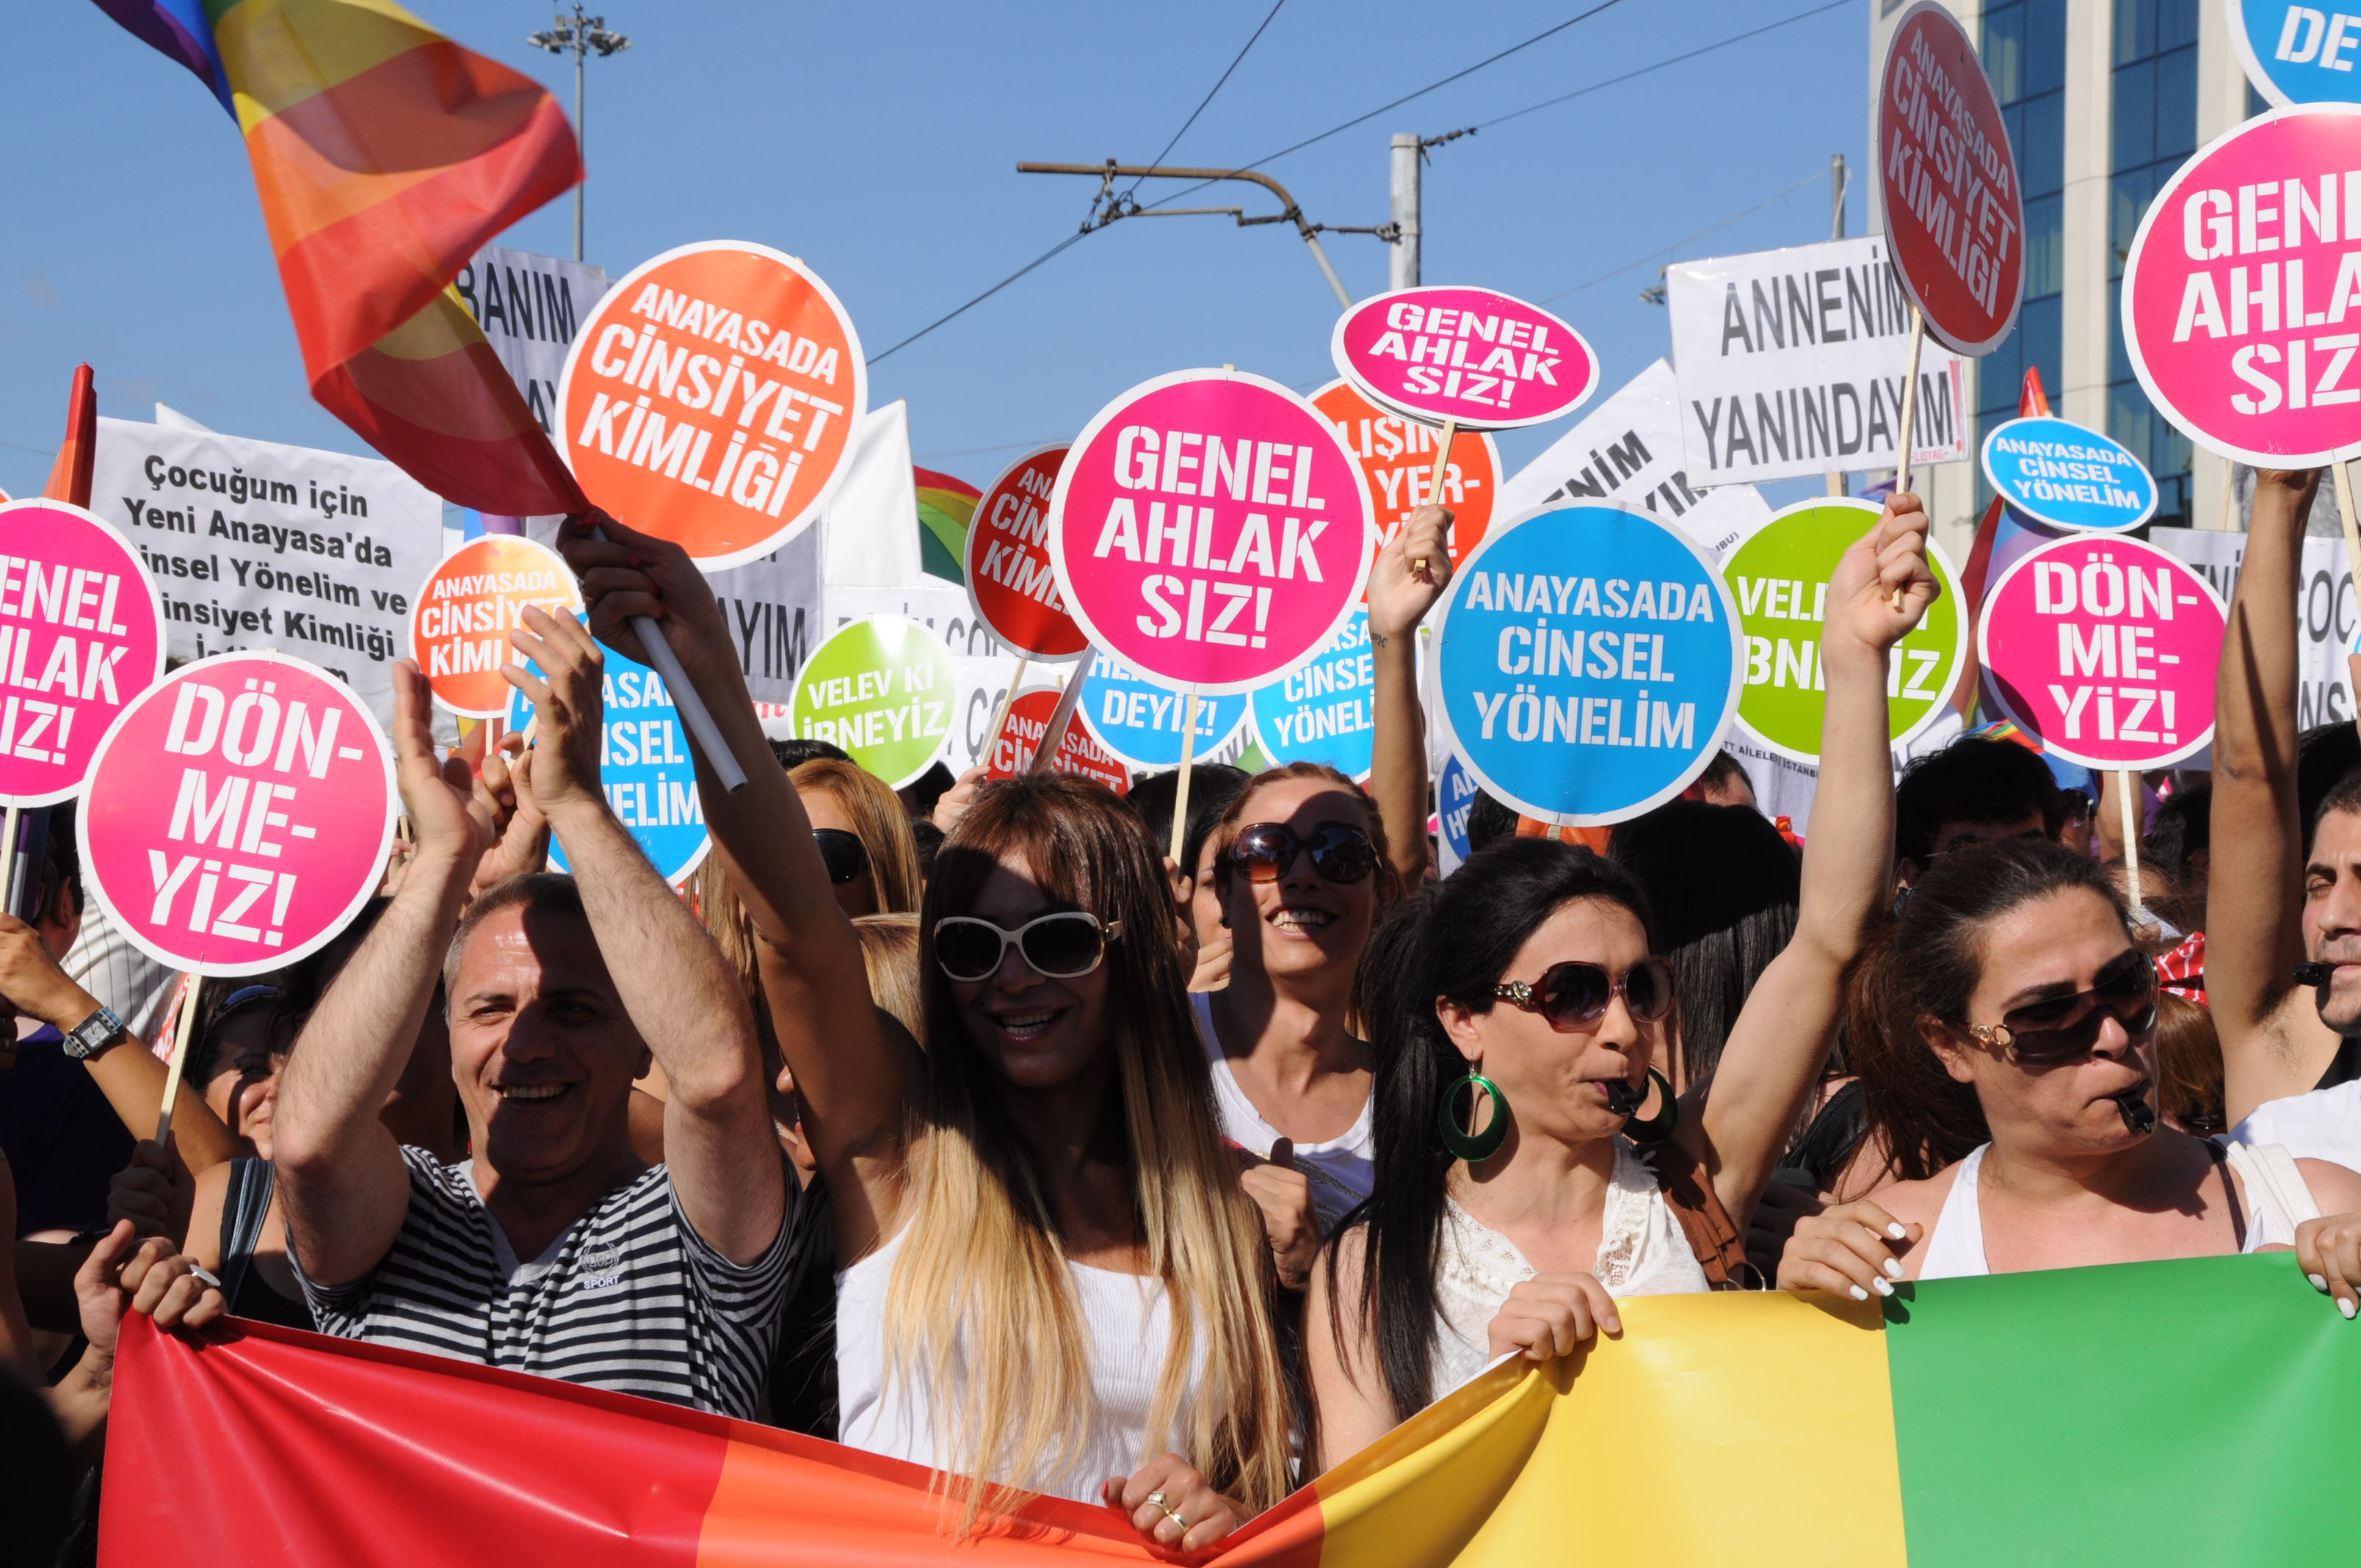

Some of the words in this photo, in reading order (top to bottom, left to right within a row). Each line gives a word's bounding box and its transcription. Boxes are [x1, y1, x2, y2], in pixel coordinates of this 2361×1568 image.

[1910, 27, 2010, 201] ANAYASADA
[631, 283, 839, 385] ANAYASADA
[1368, 331, 1562, 386] AHLAK
[1387, 302, 1559, 355] GENEL
[591, 323, 844, 452] CİNSİYET
[1402, 366, 1515, 409] SIZ!
[578, 391, 802, 518] KİMLİĞİ
[1114, 425, 1325, 510] GENEL
[1542, 429, 1653, 504] NİM
[1995, 437, 2133, 469] ANAYASADA
[2020, 456, 2121, 484] CİNSEL
[145, 454, 297, 507] Çocuğum
[309, 479, 368, 519] için
[2013, 478, 2140, 509] YÖNELİM
[123, 496, 196, 534] Yeni
[208, 508, 393, 568] Anayasa'da
[1092, 497, 1330, 583] AHLAK
[230, 557, 360, 608] Yönelim
[371, 589, 408, 615] ve
[432, 570, 558, 600] ANAYASADA
[1136, 574, 1272, 649] SIZ!
[1465, 571, 1714, 623] ANAYASADA
[2034, 553, 2198, 621] DÖN-
[284, 611, 394, 662] Kimliği
[1497, 618, 1675, 683] CİNSEL
[2057, 623, 2180, 681] ME-
[808, 668, 893, 711] VELEV
[1472, 683, 1696, 749] YÖNELİM
[164, 678, 363, 780] DÖN-
[167, 768, 316, 858] ME-
[583, 1274, 620, 1290] SPORT
